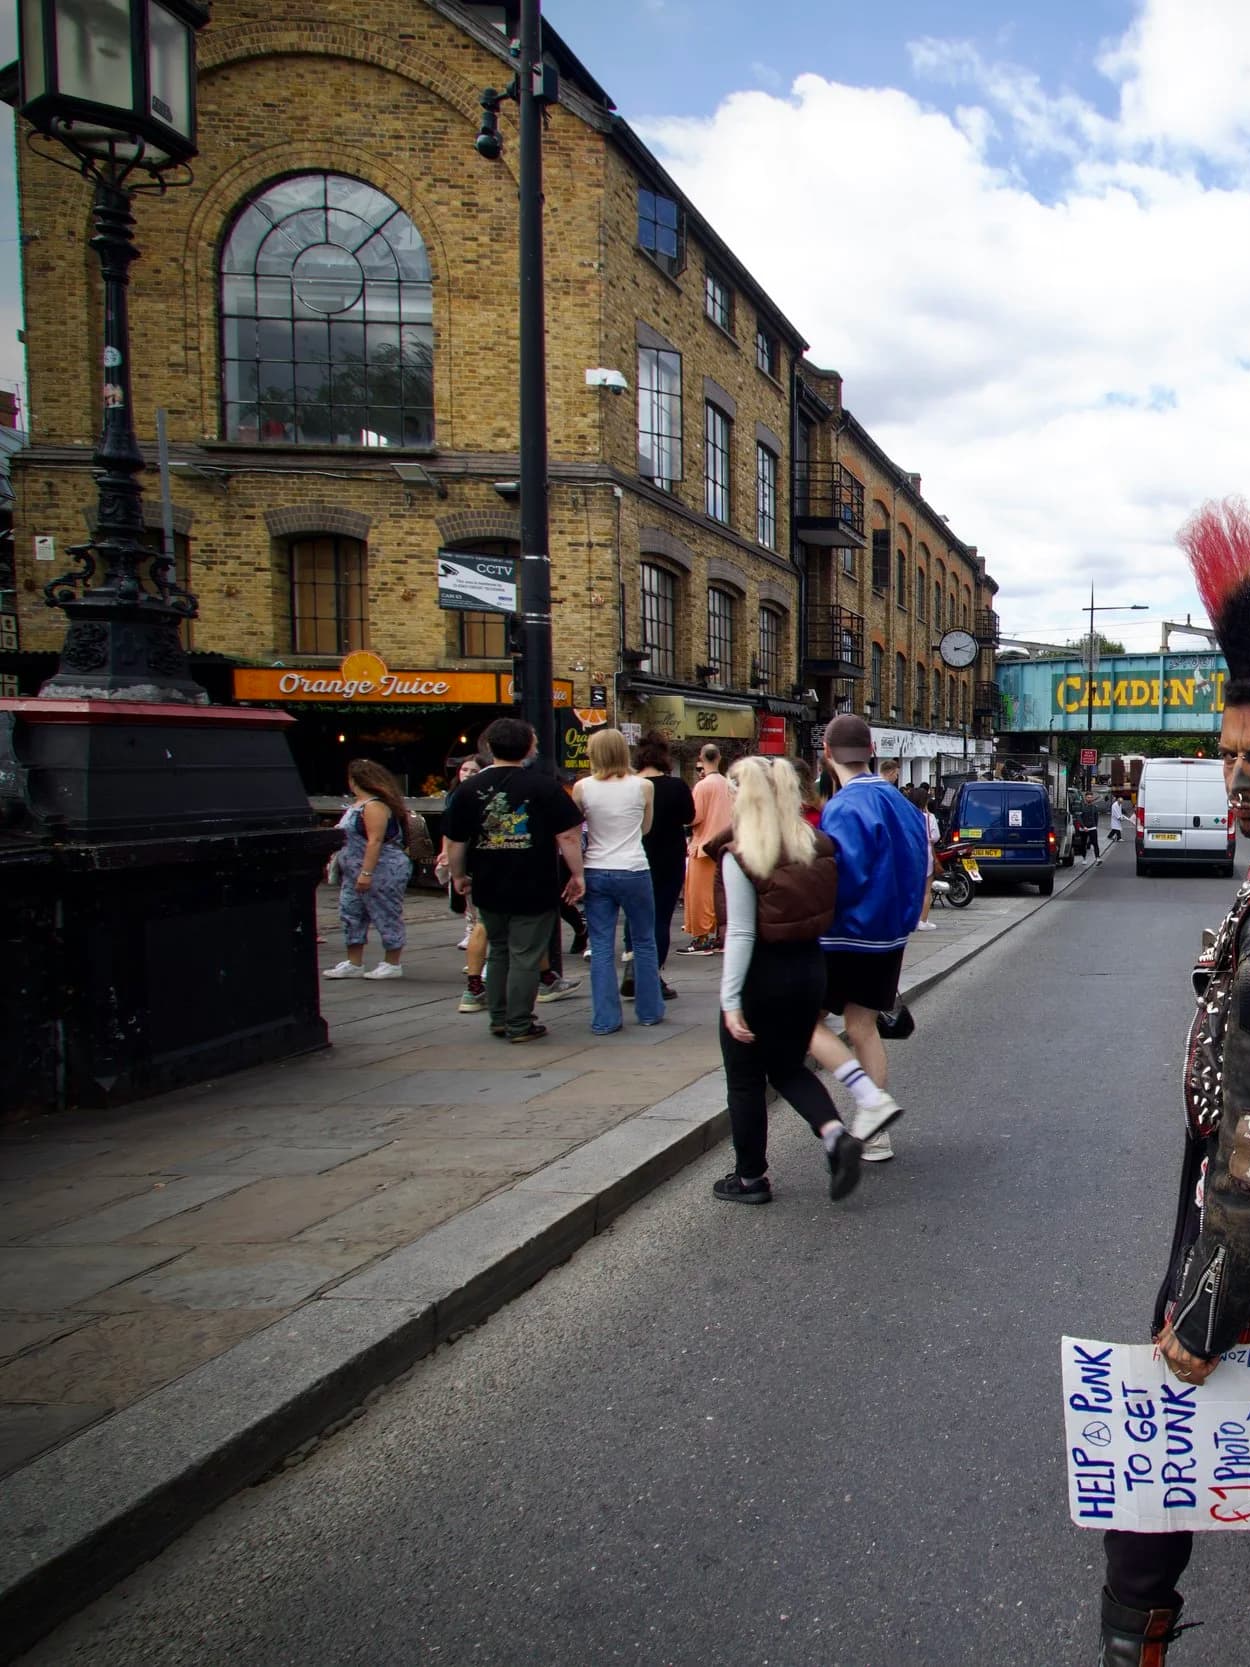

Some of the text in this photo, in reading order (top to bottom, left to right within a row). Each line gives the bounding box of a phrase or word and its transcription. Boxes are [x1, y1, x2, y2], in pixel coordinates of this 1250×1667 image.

[476, 563, 513, 576] CCTV
[279, 672, 451, 698] Orange Juice
[1056, 676, 1197, 713] CAMDEN
[1121, 1381, 1158, 1492] TO GET
[1160, 1384, 1197, 1508] DRUNK
[1072, 1446, 1116, 1519] HELP
